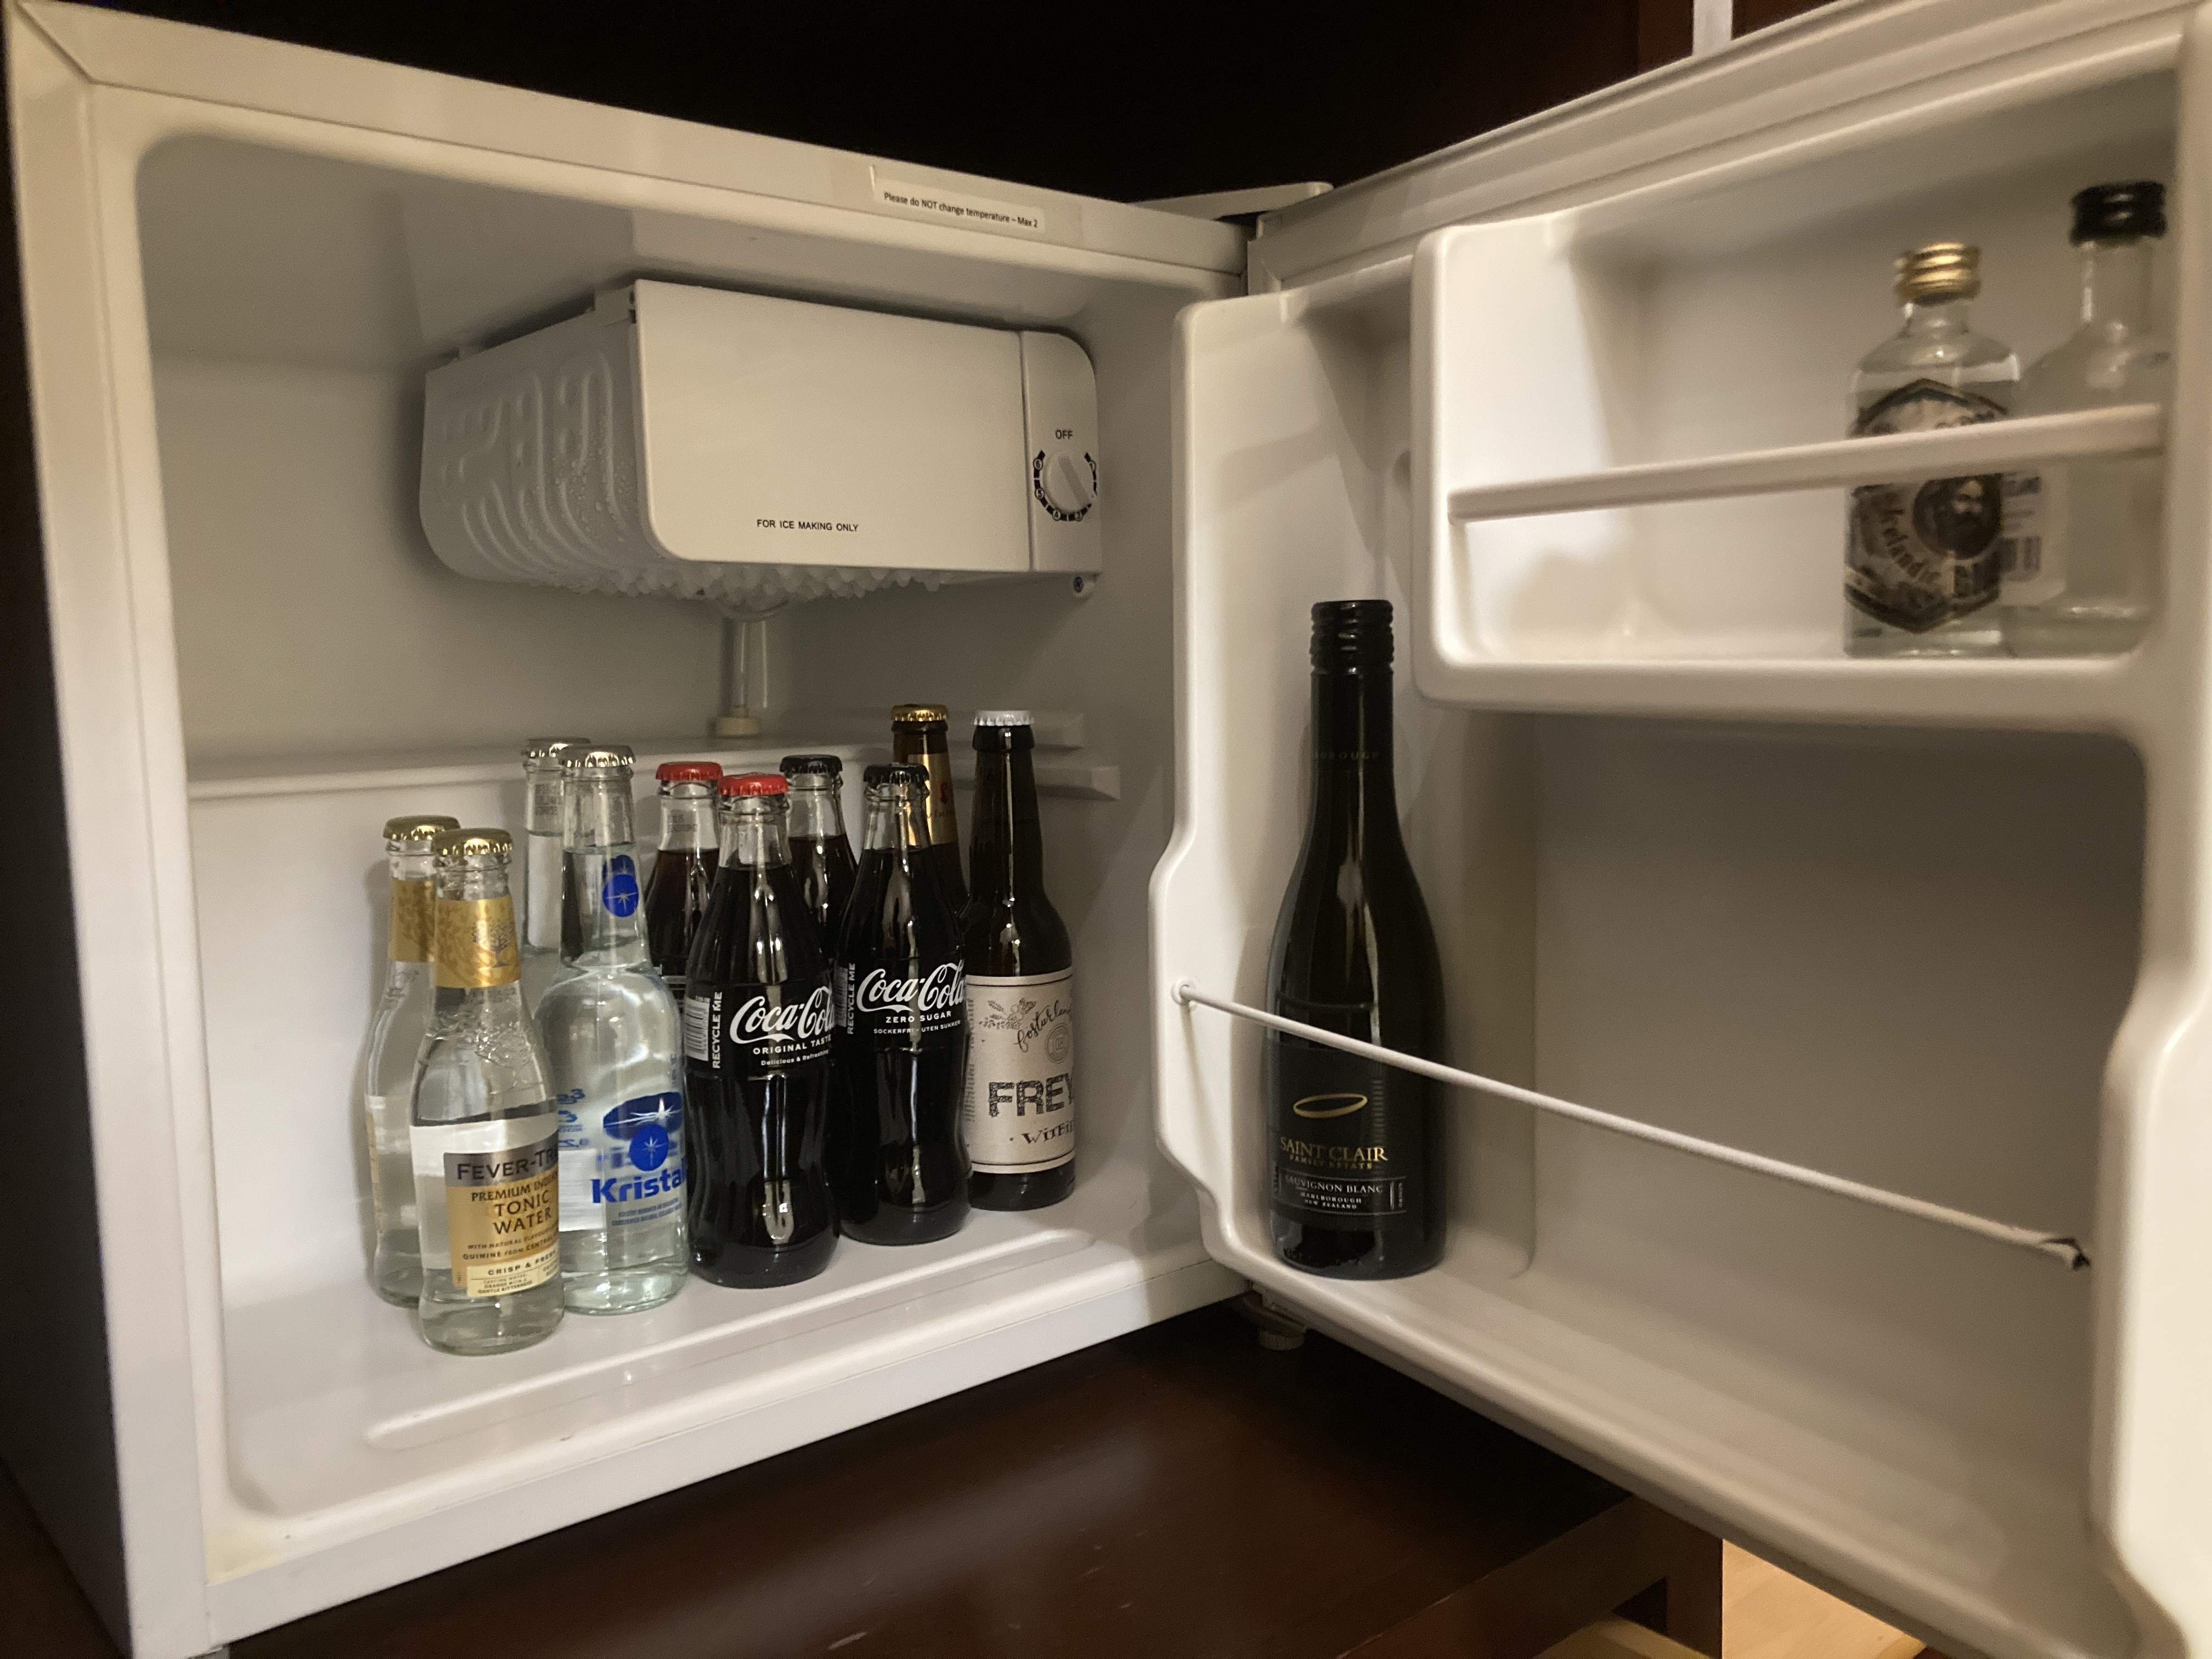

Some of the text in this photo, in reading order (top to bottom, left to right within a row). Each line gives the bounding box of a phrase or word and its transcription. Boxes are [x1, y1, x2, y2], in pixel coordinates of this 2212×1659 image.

[884, 191, 908, 205] Please
[910, 197, 919, 207] do
[921, 199, 938, 210] NOT
[939, 202, 964, 216] change
[966, 208, 1010, 223] temperature
[1017, 216, 1032, 227] Max
[1033, 219, 1038, 228] 2
[1055, 430, 1073, 439] OFF
[757, 519, 859, 532] FOR ICE MAKING ONLY
[849, 962, 855, 981] ME
[856, 960, 964, 1013] Coca-Cola
[730, 983, 834, 1044] Coca-Cola
[919, 1011, 952, 1022] SUGAR
[712, 991, 723, 1069] RECYCLE ME
[940, 1019, 961, 1030] SUKKER
[753, 1034, 832, 1055] ORIGINAL TASTE
[1280, 1136, 1389, 1162] SAINT CLAIR
[471, 1184, 531, 1201] PREMIUM
[1285, 1175, 1342, 1193] SAUVIGNON
[1346, 1184, 1384, 1194] BLANC
[494, 1190, 550, 1217] TONIC
[1300, 1192, 1362, 1204] MARLBOROUGH
[493, 1207, 552, 1234] WATER
[489, 1238, 522, 1249] NATURAL
[462, 1251, 501, 1260] QUININE
[504, 1248, 524, 1256] FROM
[488, 1265, 521, 1276] CRISP
[535, 1250, 556, 1265] FRESH
